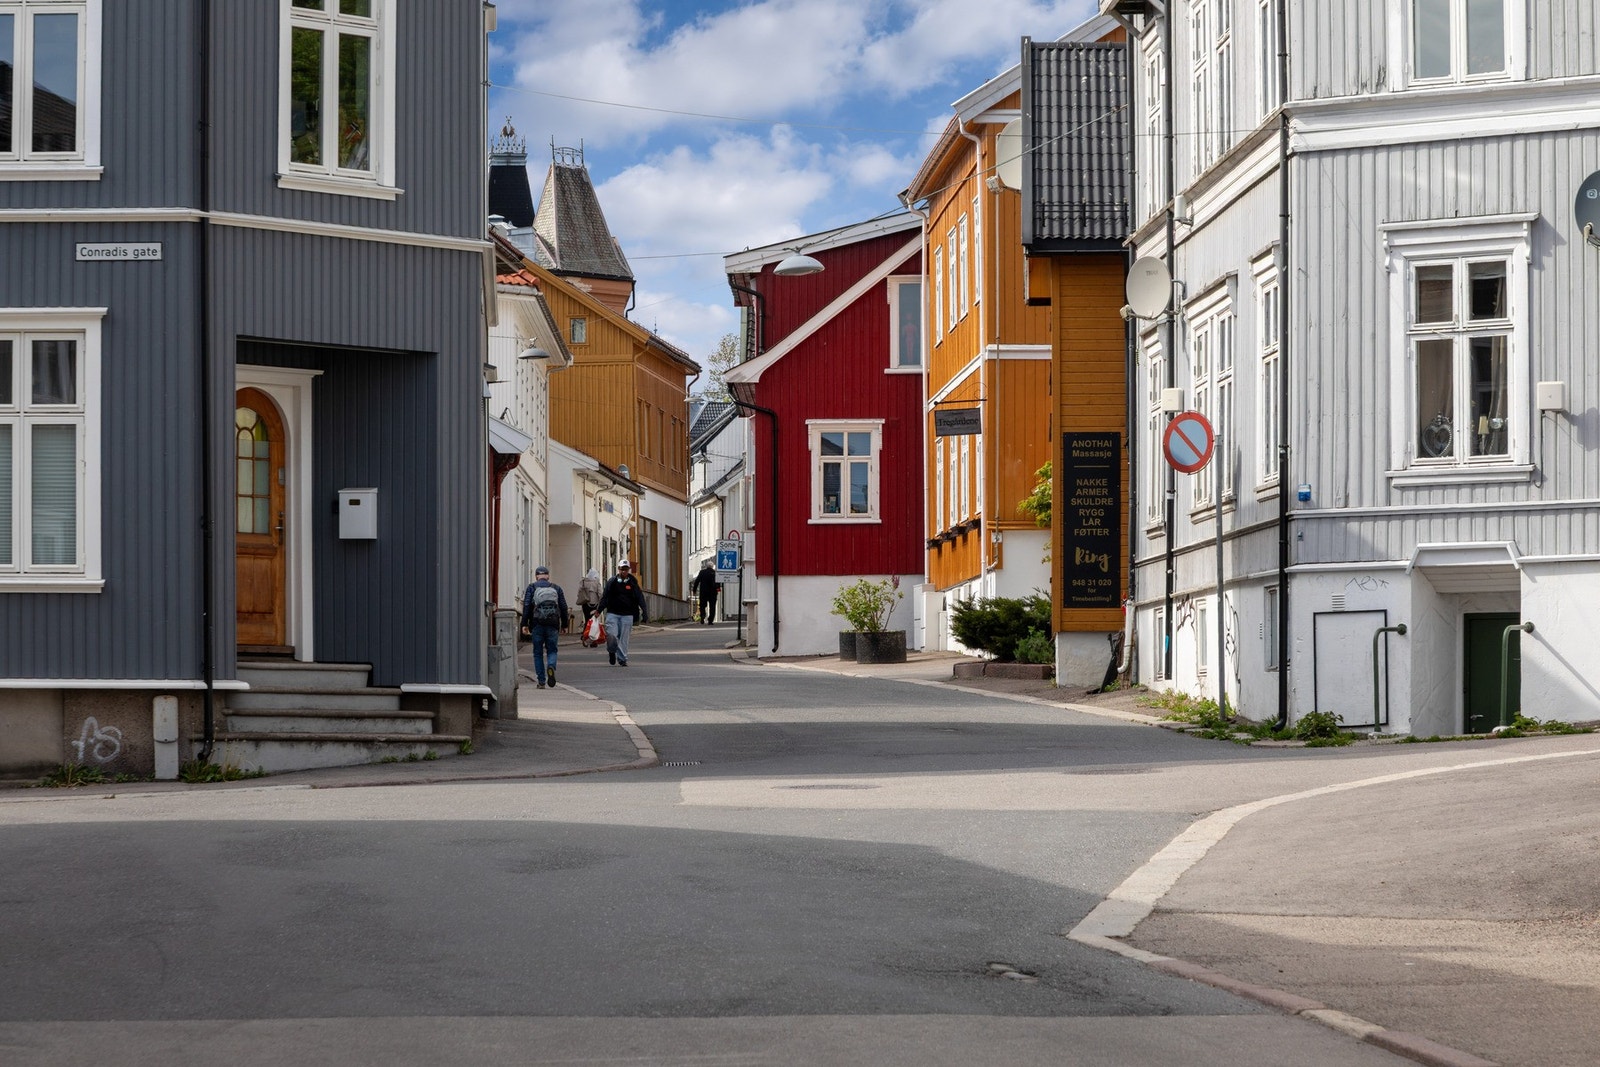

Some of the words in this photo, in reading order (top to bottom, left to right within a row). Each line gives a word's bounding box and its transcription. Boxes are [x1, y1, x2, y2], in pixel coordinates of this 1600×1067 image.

[80, 246, 128, 257] Conradis
[132, 247, 158, 259] gate
[1072, 450, 1112, 458] Massasje
[1075, 488, 1109, 496] ARMER
[1070, 497, 1114, 506] SKULDRE
[1078, 508, 1105, 517] RYGG
[1082, 517, 1101, 526] LÅR
[1074, 528, 1110, 536] FØTTER
[1074, 546, 1113, 573] Ring
